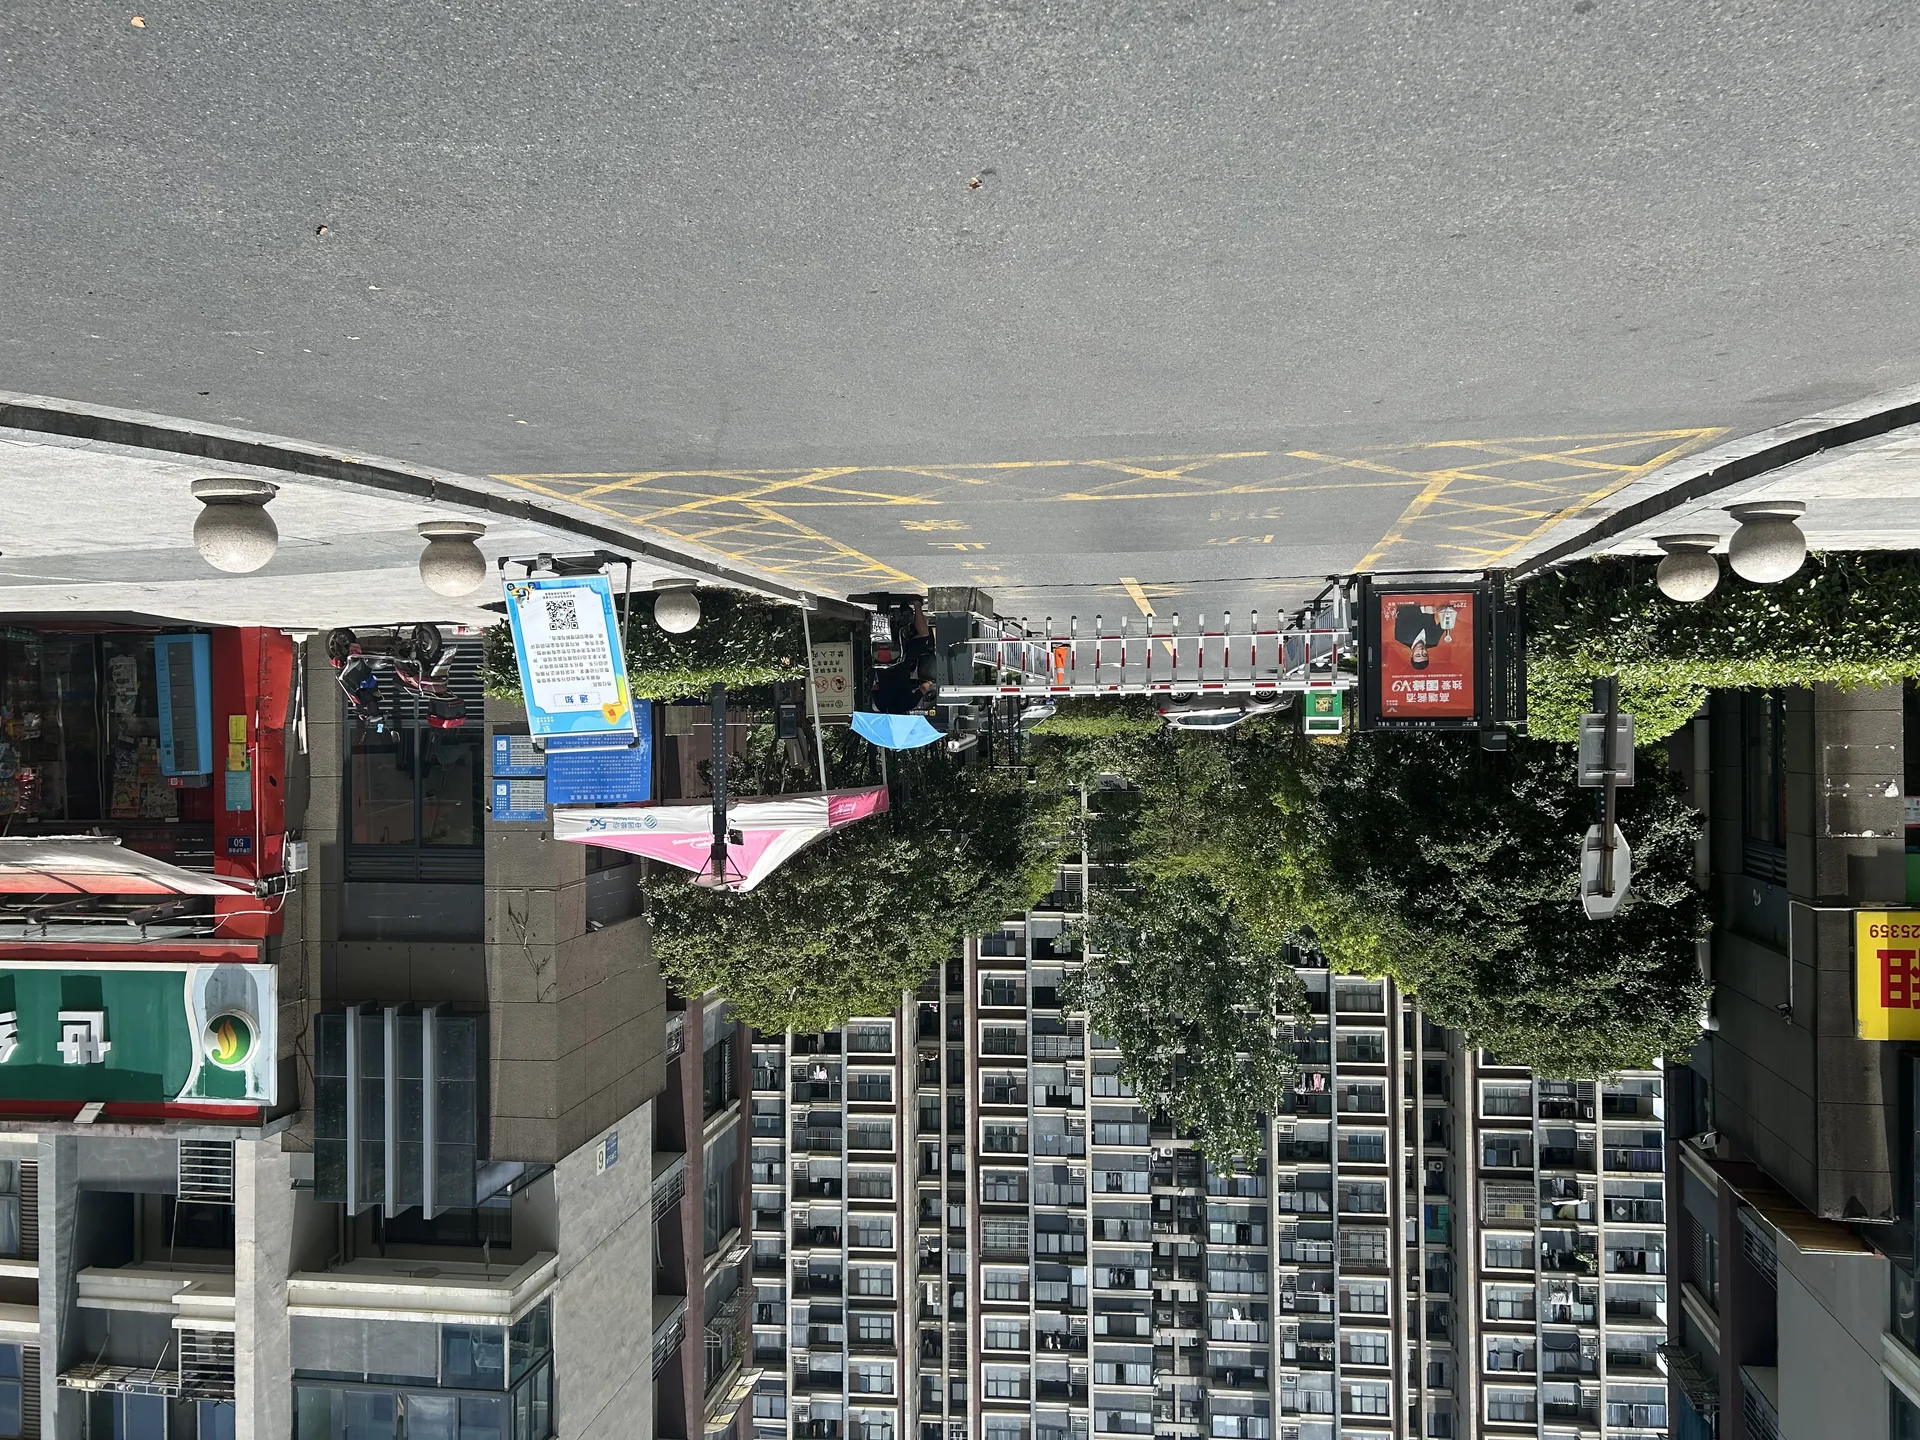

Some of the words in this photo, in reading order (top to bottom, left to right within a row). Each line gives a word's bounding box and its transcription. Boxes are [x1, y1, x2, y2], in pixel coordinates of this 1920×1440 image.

[812, 650, 844, 658] 禁止入内
[564, 694, 589, 704] 通知
[1406, 692, 1450, 703] 高端酱酒
[234, 838, 244, 846] 50
[1869, 924, 1920, 938] 25359
